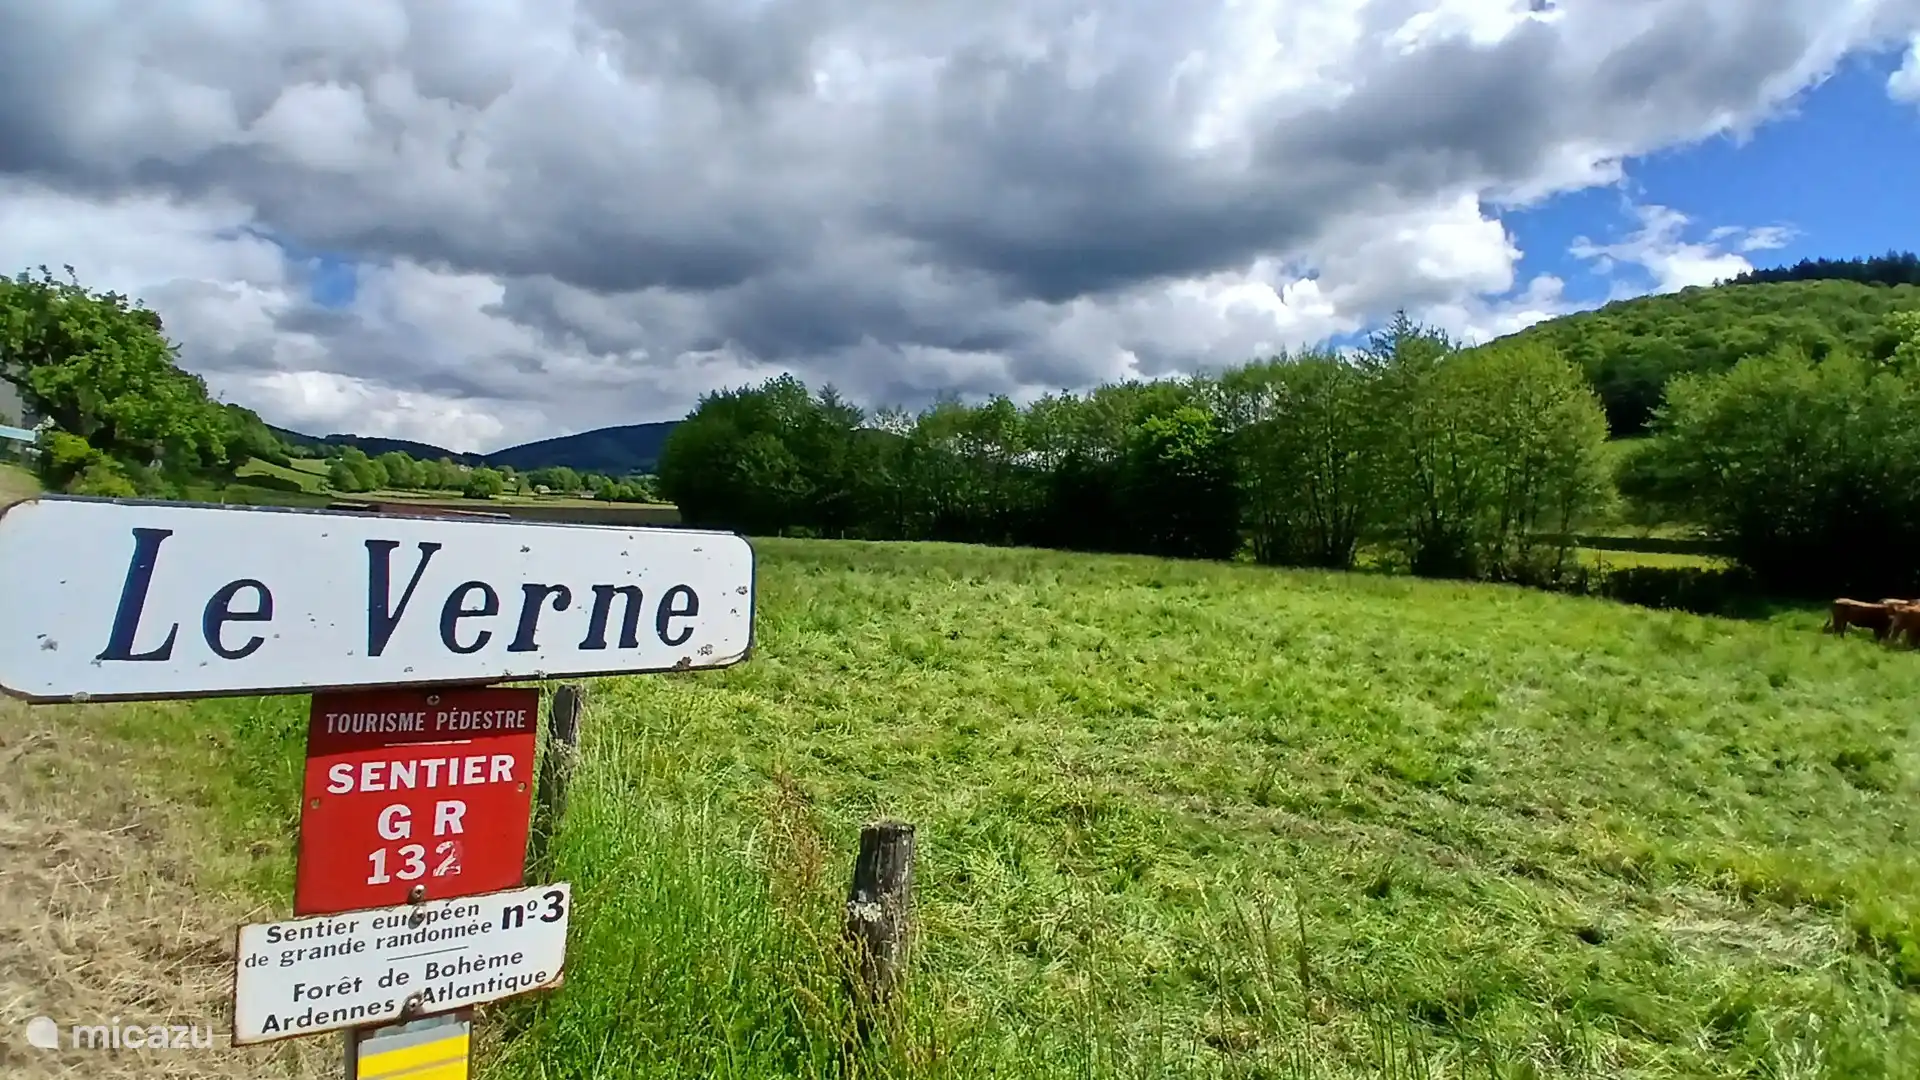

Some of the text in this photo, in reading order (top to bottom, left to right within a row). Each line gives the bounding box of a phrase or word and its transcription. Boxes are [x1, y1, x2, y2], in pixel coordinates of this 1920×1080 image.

[99, 527, 701, 661] Le Verne
[325, 712, 426, 734] TOURISME
[326, 754, 515, 794] SENTIER
[367, 841, 462, 885] 132
[244, 919, 493, 969] de grande randonnée
[266, 919, 360, 944] Sentier
[372, 901, 480, 930] eurpéen
[292, 950, 524, 1002] Forêt de Bohème
[261, 970, 548, 1034] Ardennes Atlantique
